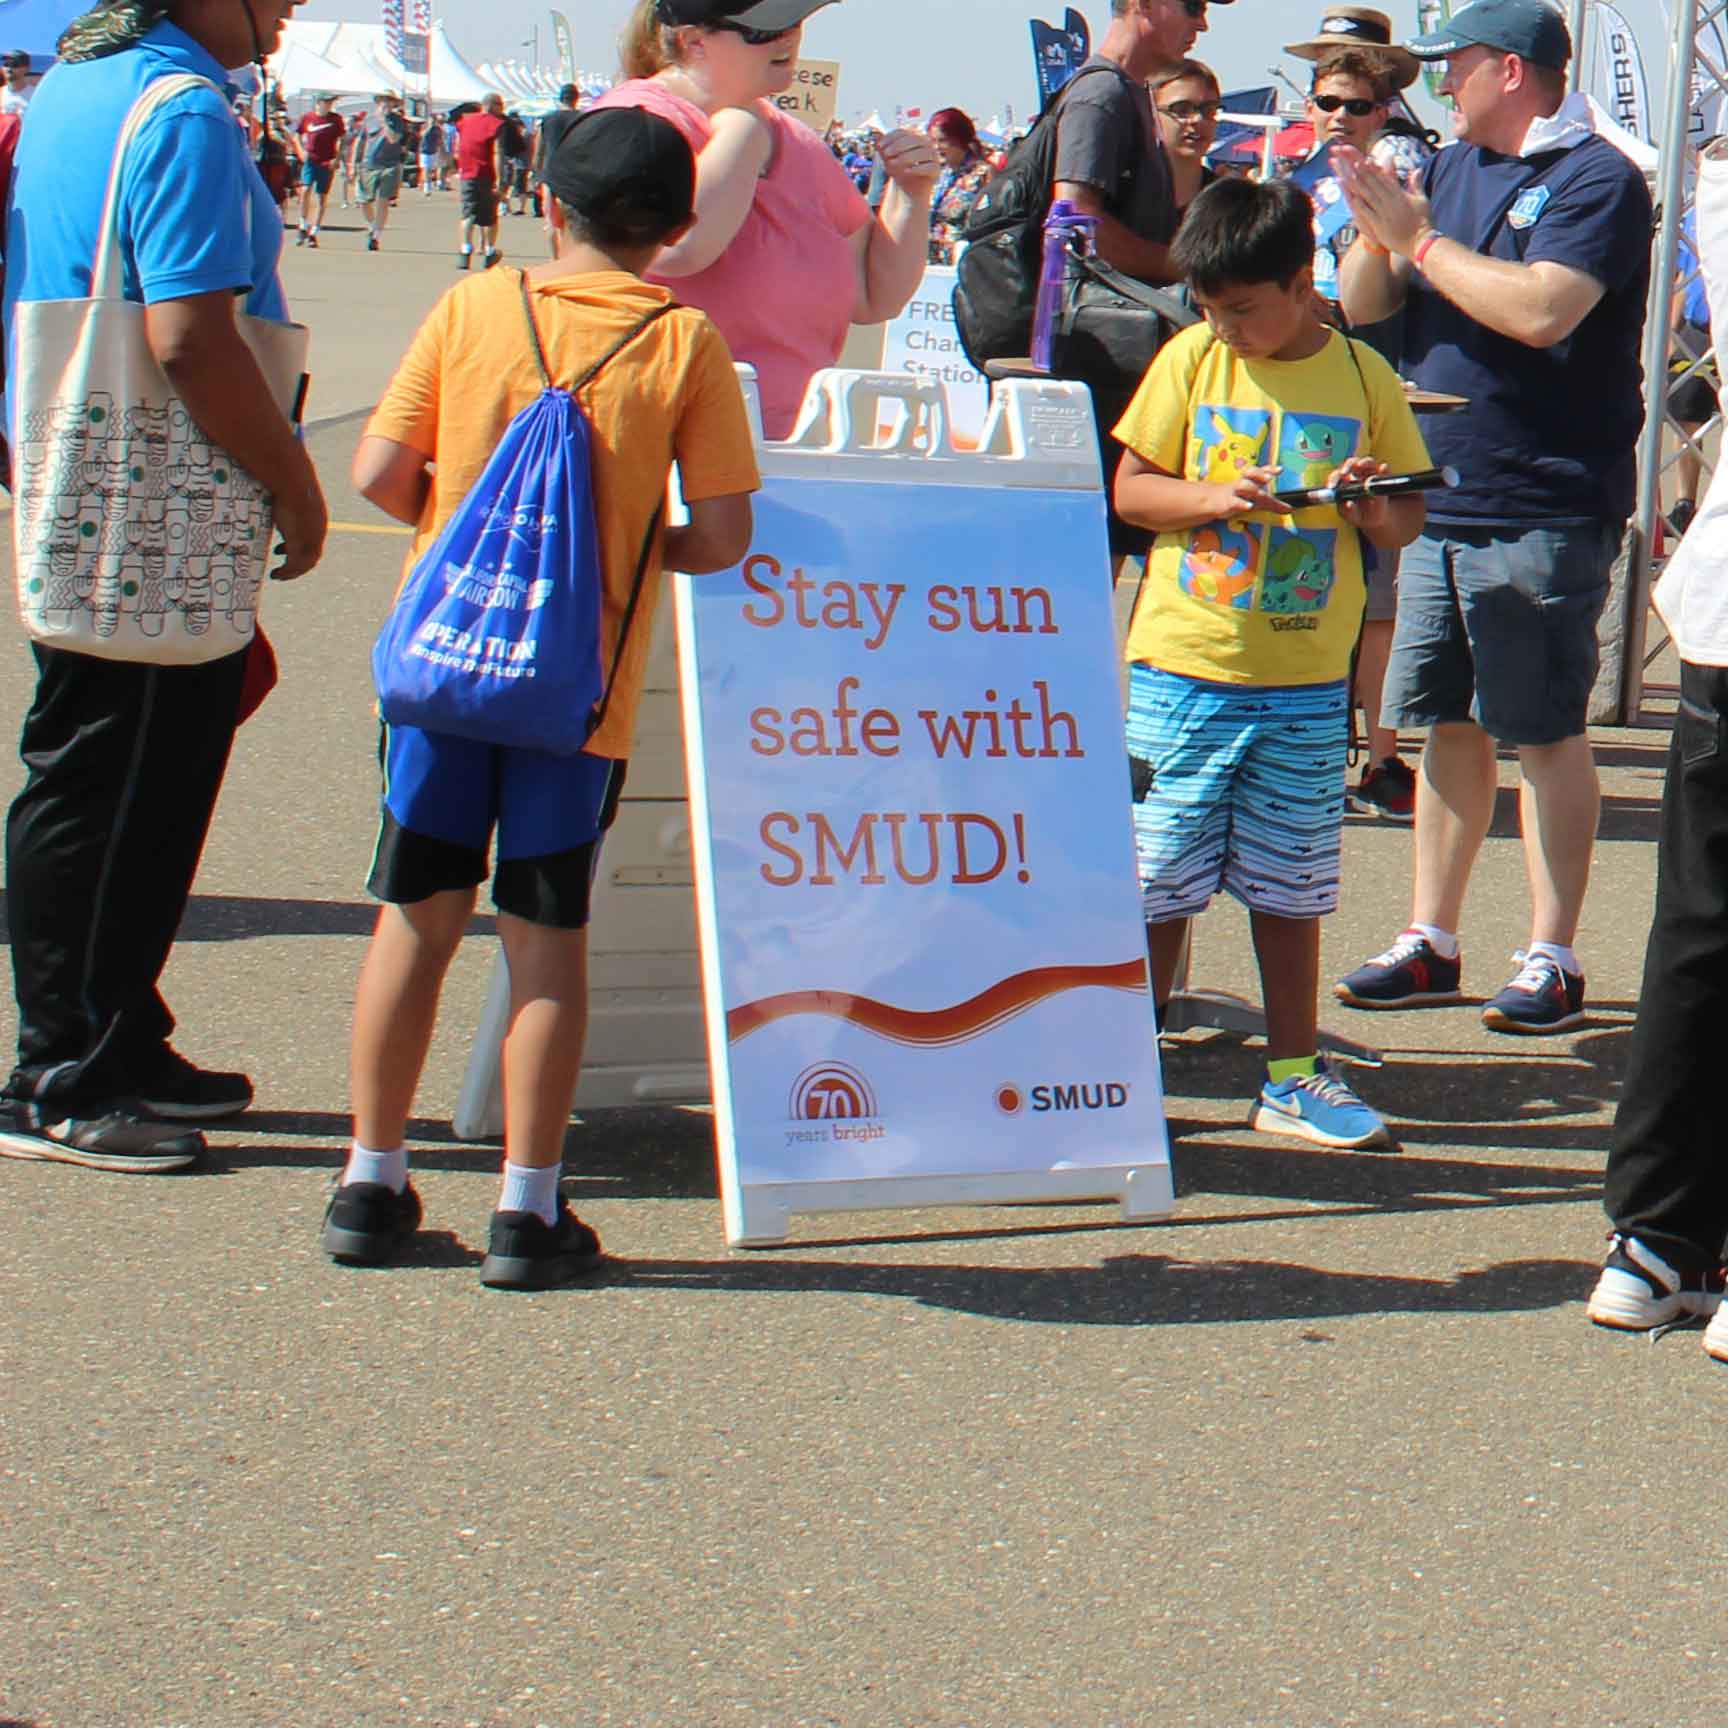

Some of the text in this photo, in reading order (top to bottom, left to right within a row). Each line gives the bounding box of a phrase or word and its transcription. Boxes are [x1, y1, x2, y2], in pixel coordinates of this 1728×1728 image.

[742, 553, 1059, 650] Stay sun
[749, 676, 1085, 759] safe with
[759, 812, 1031, 887] SMUD!
[809, 1089, 847, 1120] 70
[1032, 1083, 1128, 1112] SMUD
[785, 1123, 886, 1146] years bright
